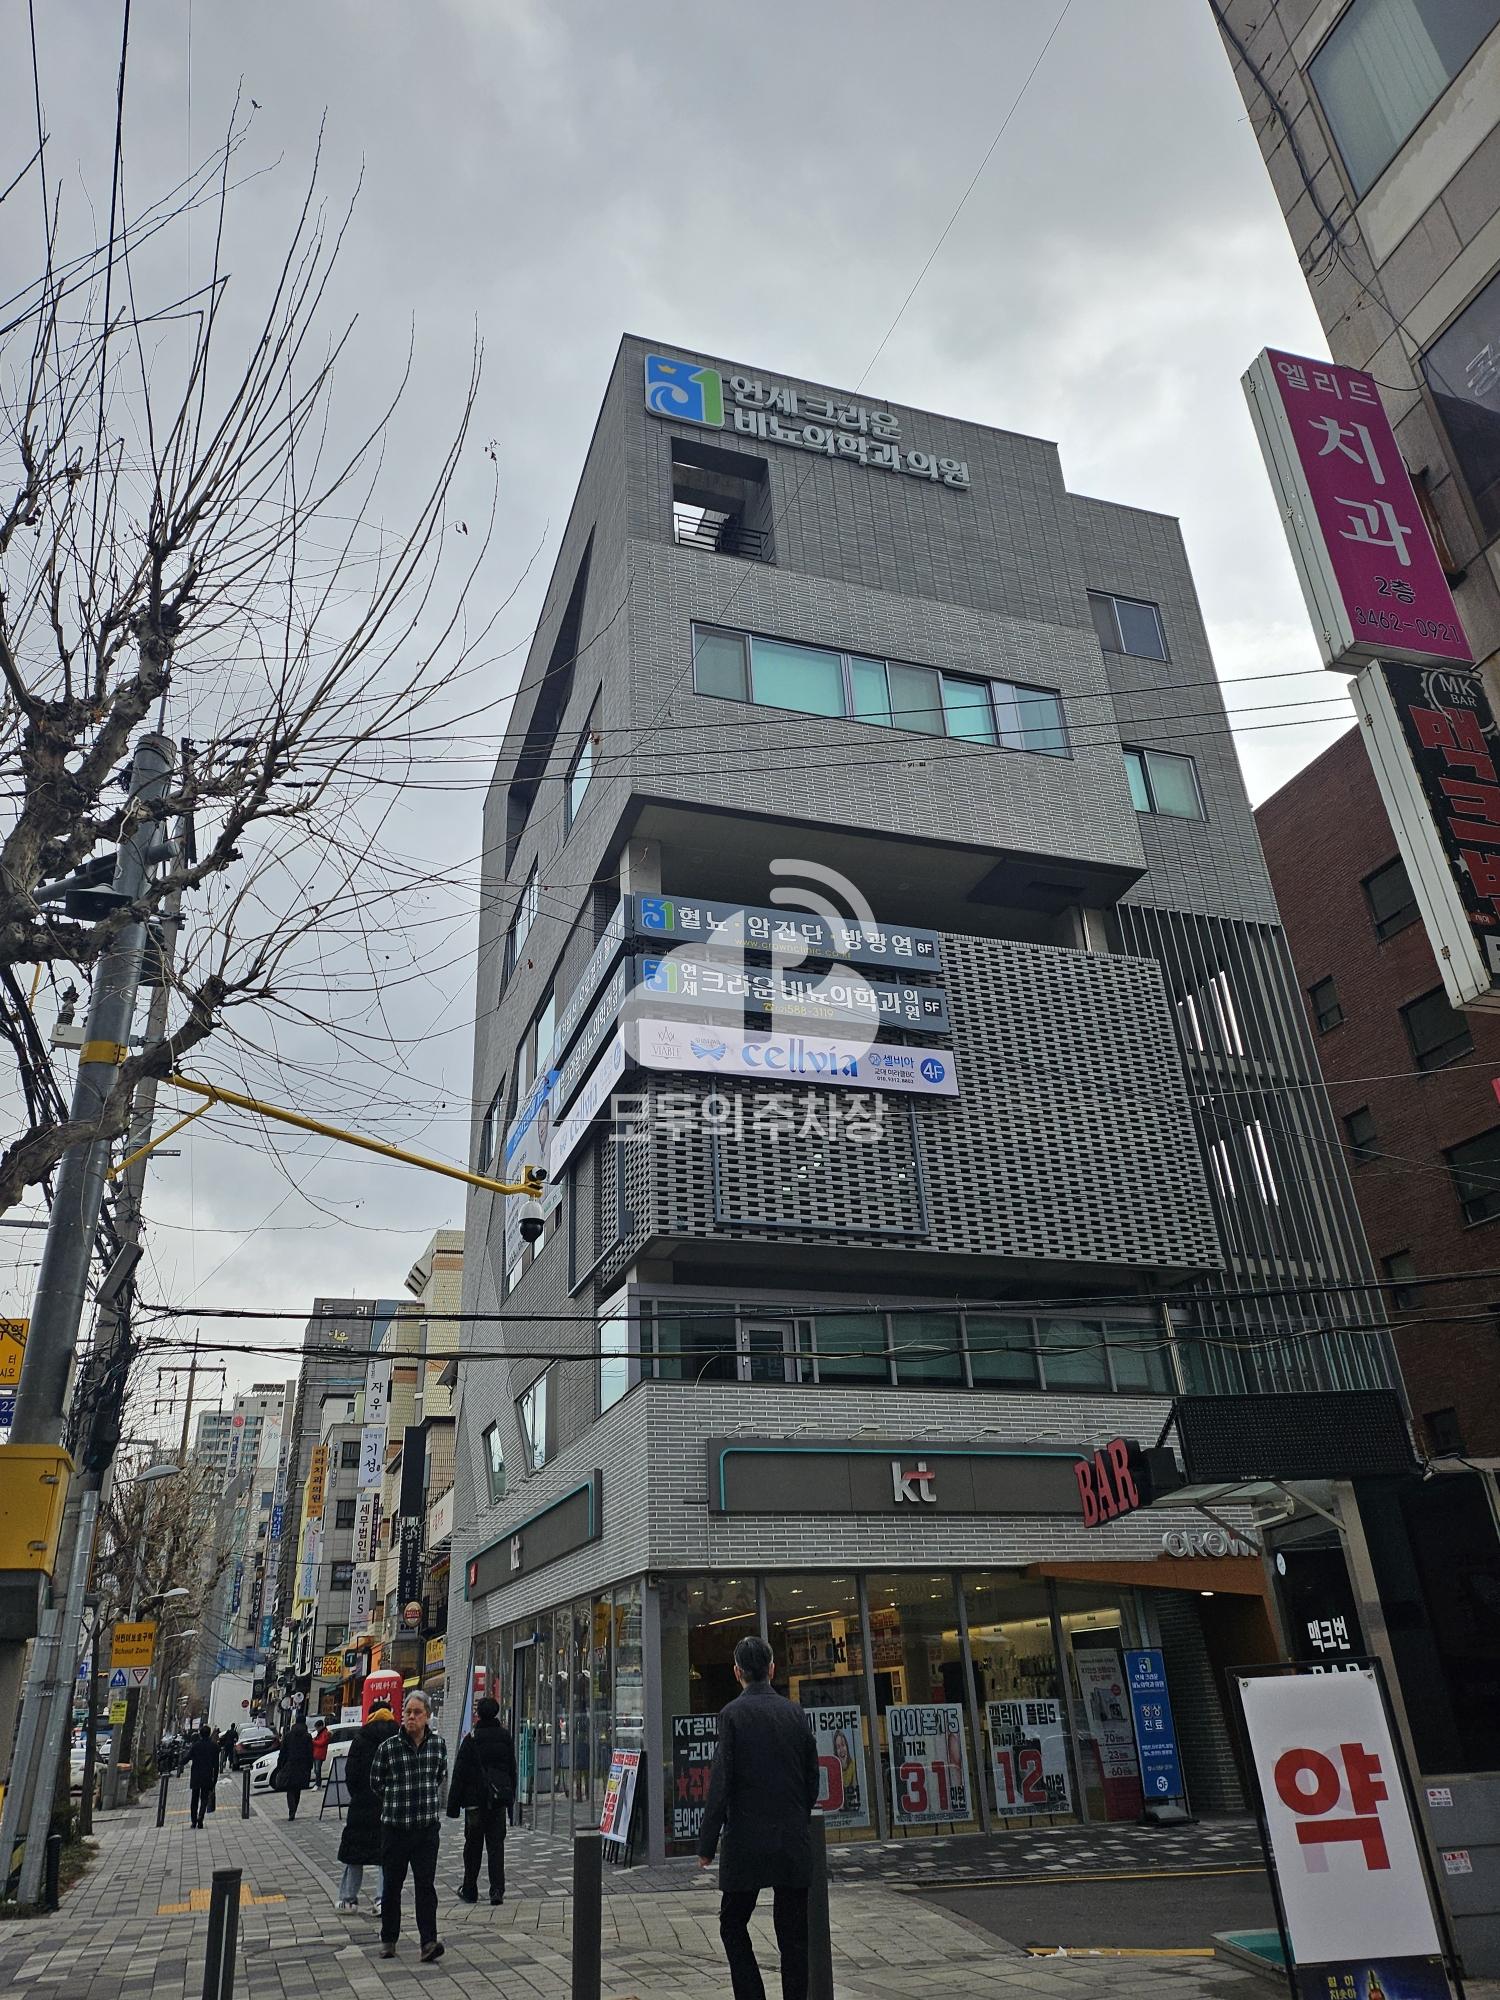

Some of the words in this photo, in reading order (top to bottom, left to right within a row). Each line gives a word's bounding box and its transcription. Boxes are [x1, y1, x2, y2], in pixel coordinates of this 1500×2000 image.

[729, 374, 799, 417] 연세
[804, 396, 902, 442] 크라운
[733, 407, 903, 474] 비뇨의학과
[906, 449, 971, 491] 의원
[1308, 414, 1412, 567] 치과
[1374, 575, 1416, 605] 2층
[1354, 606, 1462, 644] 3462-0921
[1439, 673, 1477, 698] MK
[1451, 693, 1477, 708] BAR
[677, 906, 729, 932] 혈뇨
[747, 915, 824, 946] 암진단
[840, 929, 914, 958] 방광염
[917, 942, 933, 954] 6F
[681, 962, 698, 997] 연세
[903, 988, 921, 1022] 의원
[924, 1001, 940, 1014] 5F
[742, 1037, 859, 1078] cellvia
[883, 1054, 915, 1069] 셀비아
[923, 1061, 943, 1080] 4F
[370, 1382, 385, 1411] 자우
[363, 1442, 378, 1474] 기성
[891, 1460, 937, 1503] kt
[1074, 1437, 1139, 1528] BAR
[357, 1503, 370, 1552] 세무법인
[405, 1542, 414, 1575] MUSIC
[114, 1647, 134, 1655] School
[831, 1636, 848, 1664] kt
[819, 1710, 858, 1731] S23FE
[889, 1707, 961, 1737] 아이폰15
[1026, 1703, 1057, 1726] 플립5
[1142, 1704, 1162, 1717] 정상
[1144, 1719, 1165, 1731] 진료
[674, 1716, 719, 1737] KT공식
[680, 1741, 719, 1761] -교대
[900, 1761, 949, 1813] 31
[996, 1750, 1048, 1805] 12
[1157, 1777, 1168, 1790] 5F
[1273, 1742, 1392, 1871] 약
